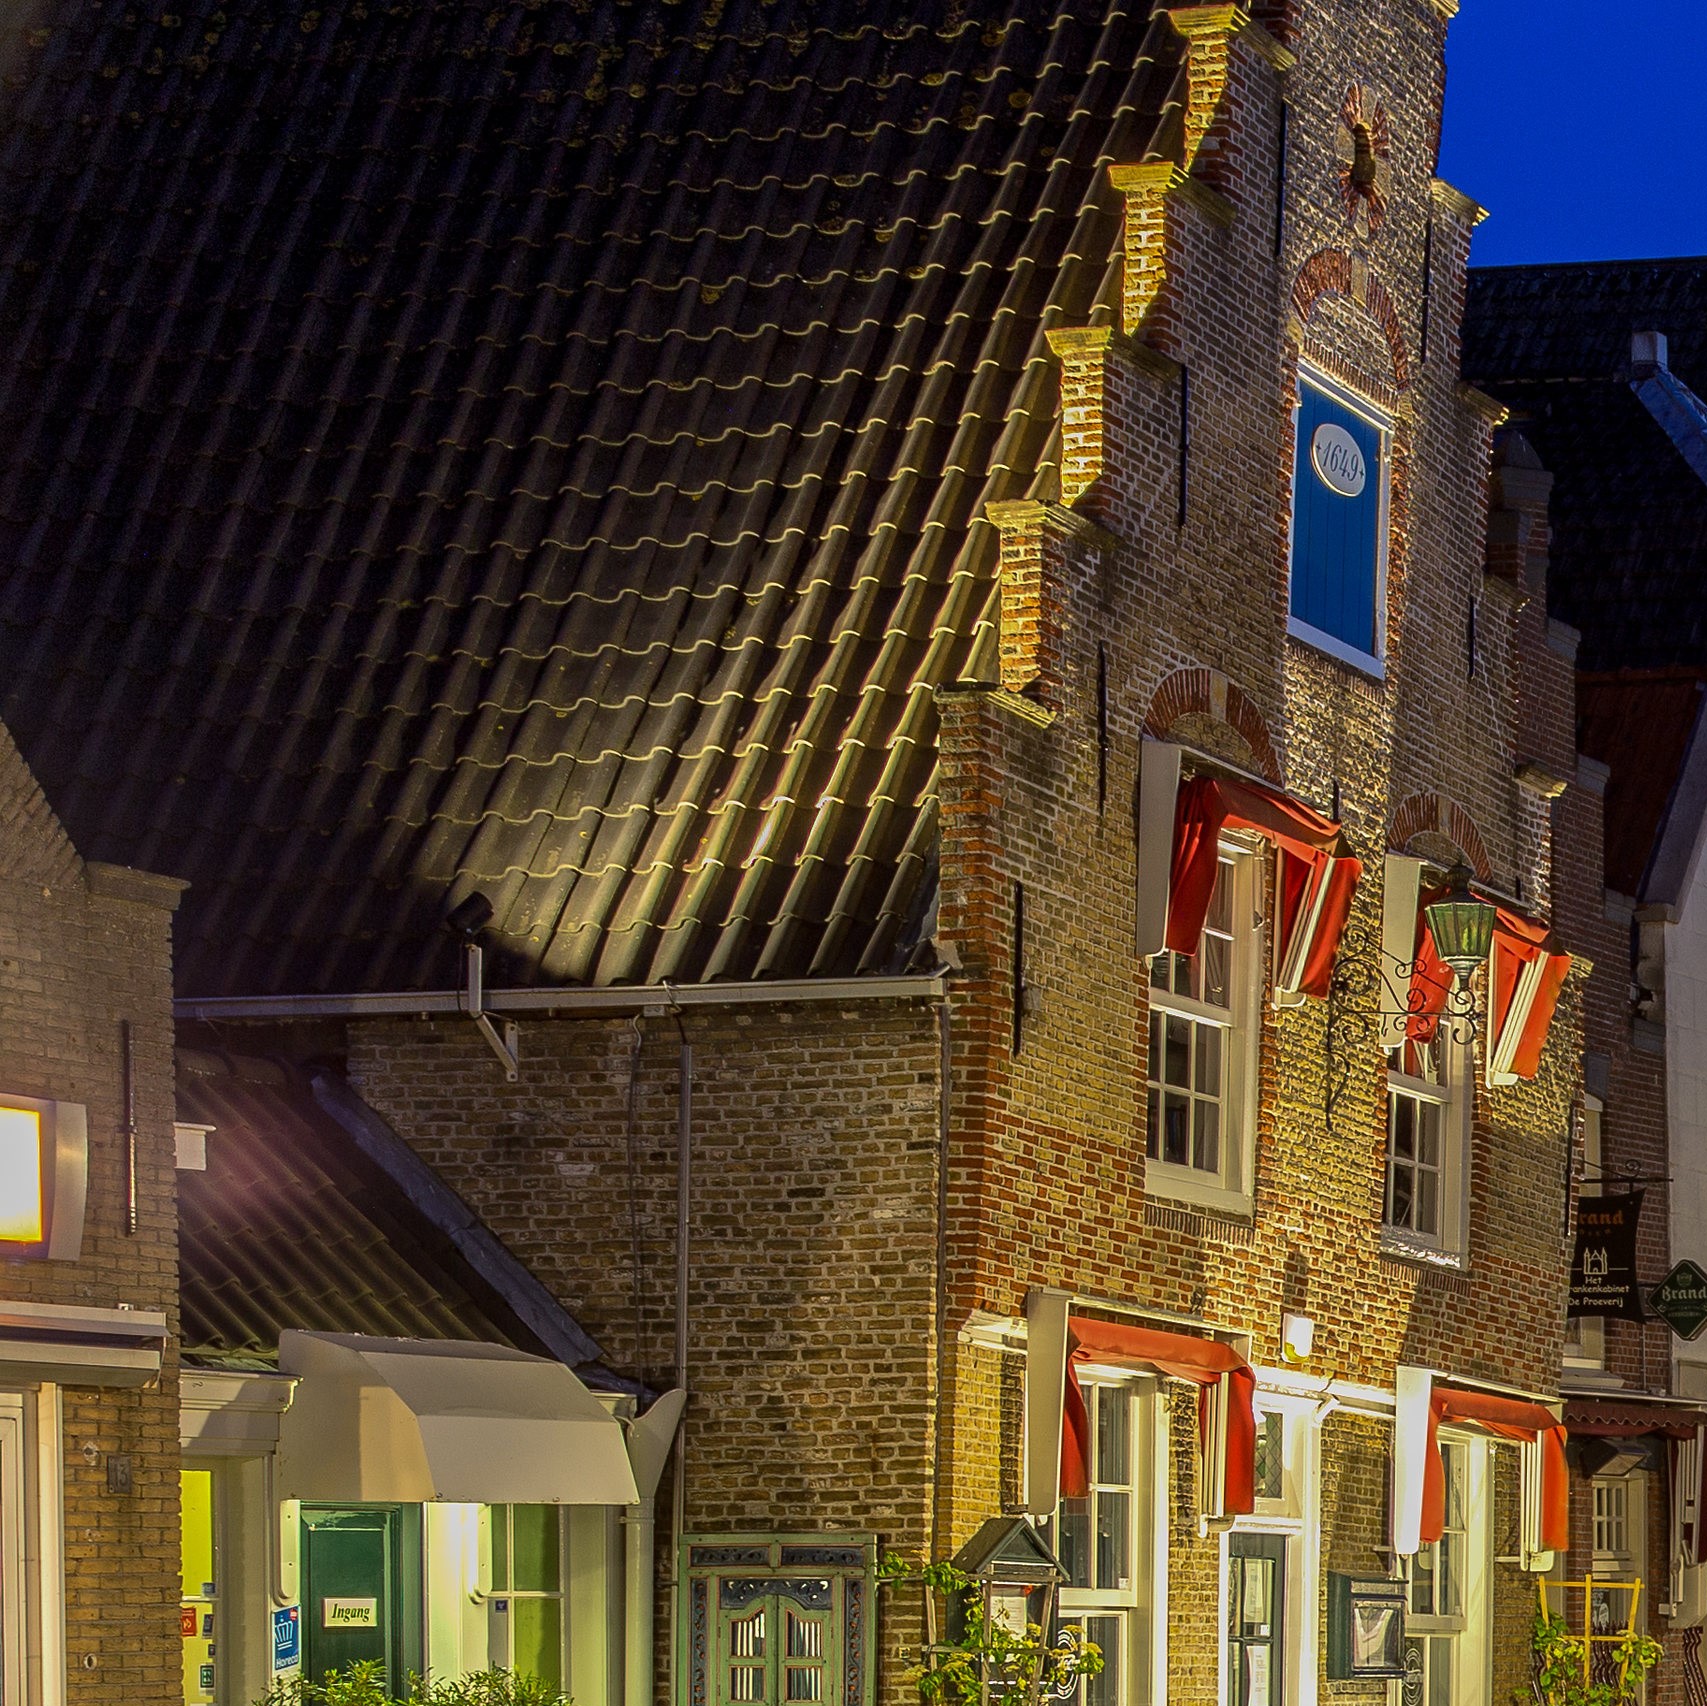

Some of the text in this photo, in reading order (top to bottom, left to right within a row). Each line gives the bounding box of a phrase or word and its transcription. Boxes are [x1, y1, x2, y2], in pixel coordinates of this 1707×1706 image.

[1322, 440, 1359, 481] 1649
[1579, 1210, 1624, 1225] rand
[1585, 1276, 1602, 1285] Het
[1569, 1285, 1630, 1293] rankenkabinet
[1662, 1286, 1707, 1301] Brand
[1583, 1297, 1623, 1307] Proeverij
[331, 1603, 370, 1622] Ingang
[275, 1654, 299, 1668] Horeca
